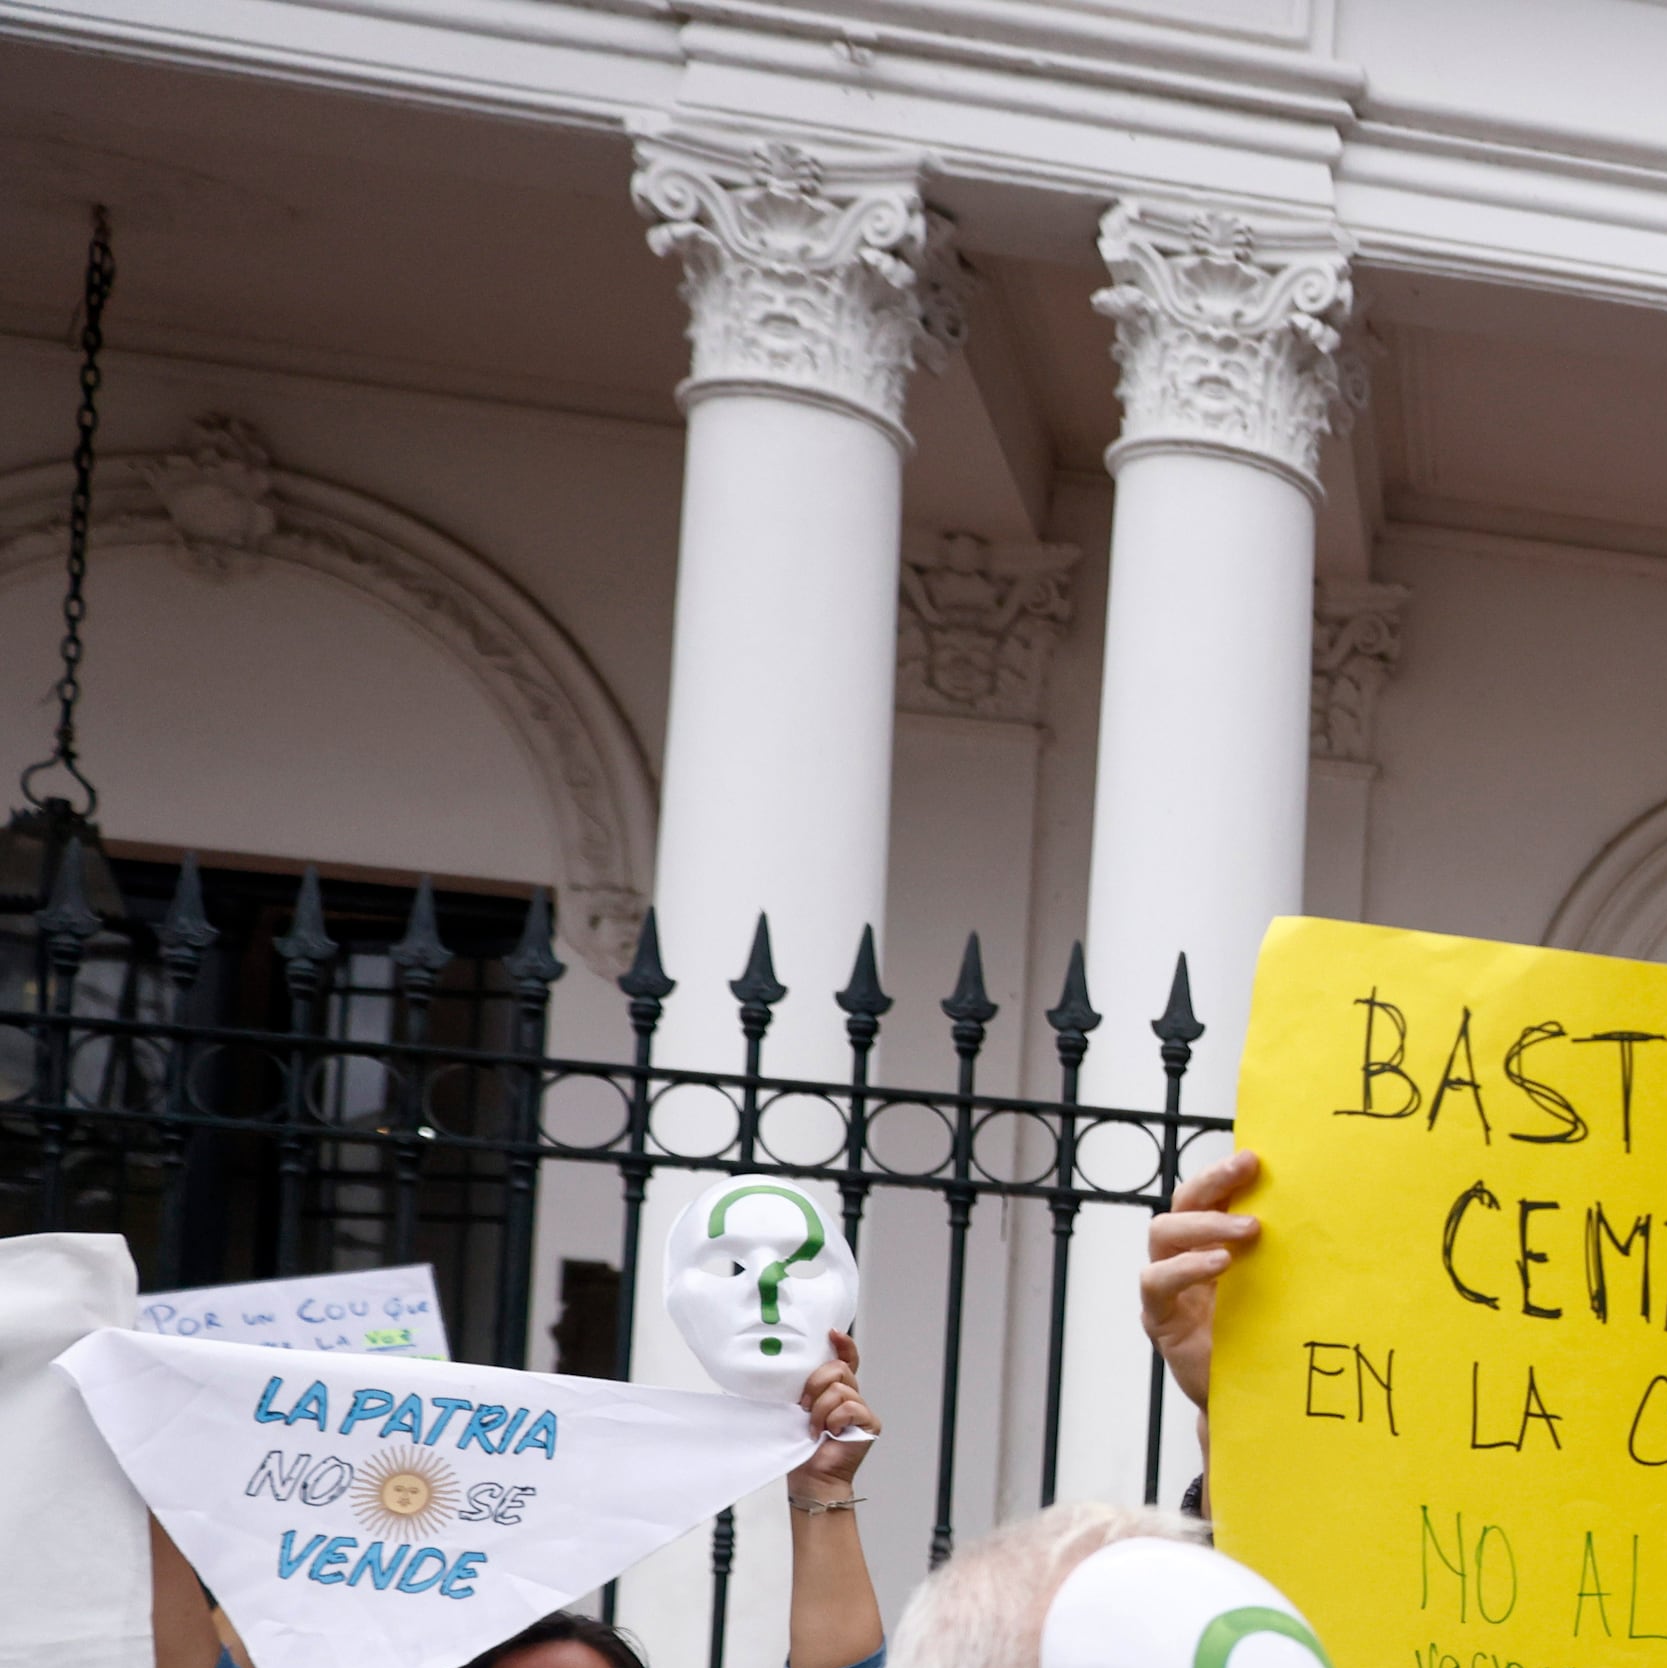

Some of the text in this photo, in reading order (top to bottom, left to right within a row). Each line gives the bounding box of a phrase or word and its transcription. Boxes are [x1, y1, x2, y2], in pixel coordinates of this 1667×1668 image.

[145, 1304, 223, 1336] POR
[297, 1298, 369, 1323] COU
[315, 1335, 350, 1351] LA
[254, 1376, 557, 1460] LA PATRIA
[1303, 1341, 1399, 1437] EN
[1470, 1361, 1563, 1452] LA
[244, 1450, 537, 1526] NO SE
[278, 1529, 488, 1600] VENDE
[1420, 1505, 1517, 1624] NO
